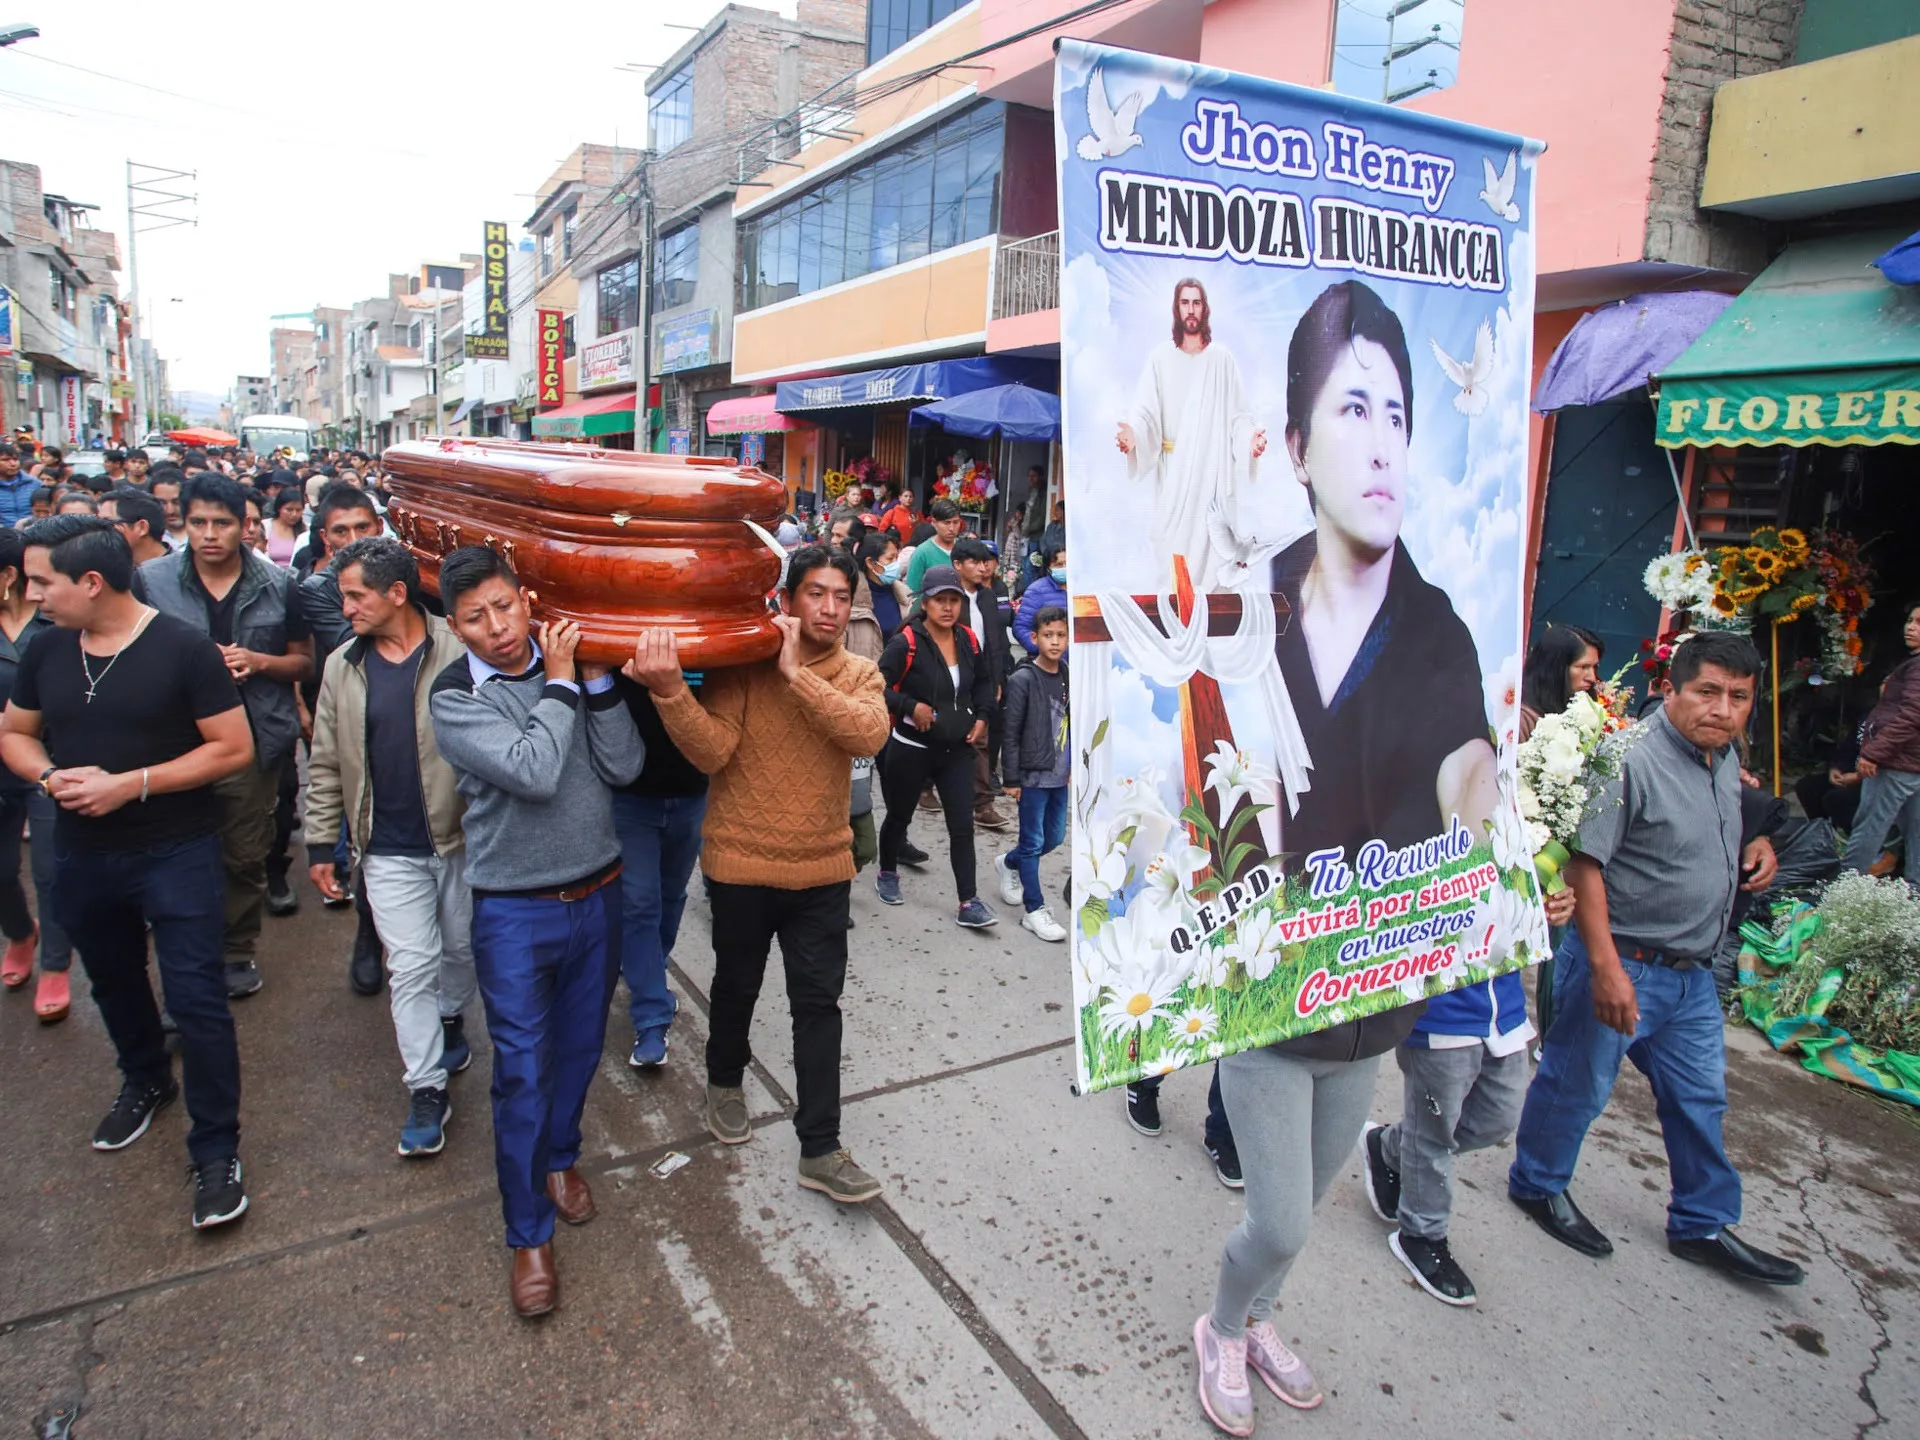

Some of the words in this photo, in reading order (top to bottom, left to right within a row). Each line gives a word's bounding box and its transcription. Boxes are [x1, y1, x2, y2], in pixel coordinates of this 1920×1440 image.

[1187, 107, 1311, 171] Jhon
[1328, 130, 1451, 203] Henry
[1105, 180, 1305, 260] MENDOZA
[1318, 204, 1501, 285] HUARANCCA
[486, 224, 505, 332] HOSTAL
[542, 313, 560, 401] BOTICA
[803, 385, 843, 405] FLORERIA
[865, 378, 897, 399] EMELY
[66, 378, 78, 444] VIDRIERIA
[1309, 850, 1351, 895] Tu
[1359, 817, 1471, 886] Recuerdo
[1170, 864, 1285, 955] Q.E.P.D.
[1279, 898, 1359, 941] vivirá
[1368, 891, 1413, 923] por
[1418, 862, 1497, 909] siempre
[1340, 937, 1369, 964] en
[1376, 909, 1475, 950] nuestros
[1298, 951, 1452, 1015] Corazones
